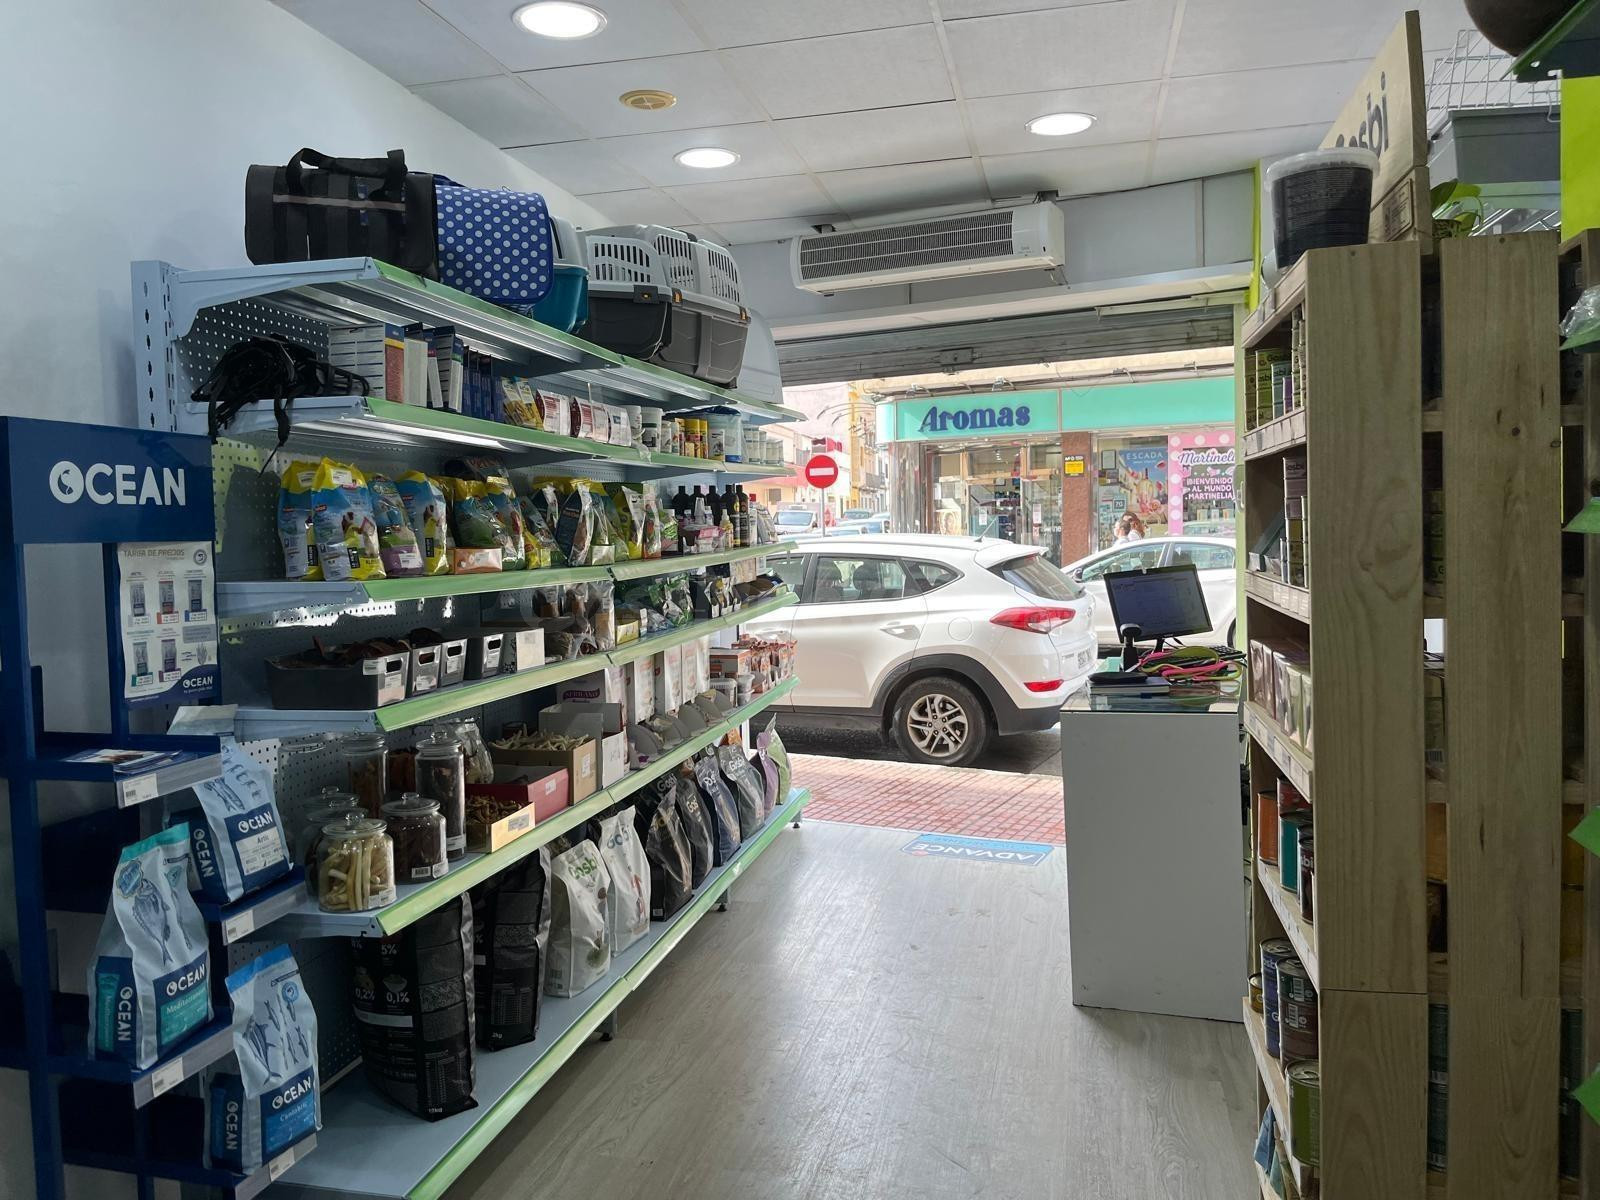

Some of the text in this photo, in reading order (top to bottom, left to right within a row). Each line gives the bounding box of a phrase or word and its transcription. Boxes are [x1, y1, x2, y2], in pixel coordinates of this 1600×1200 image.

[1335, 71, 1389, 159] sbi
[918, 406, 1031, 432] Aromas
[1126, 451, 1164, 461] ESCADA
[49, 460, 186, 506] OCEAN
[1188, 492, 1233, 500] MARTINELIA
[1204, 484, 1232, 492] MUNDO
[182, 676, 214, 688] OCEAN
[238, 811, 273, 834] OCEAN
[193, 828, 216, 878] OCEAN
[913, 843, 1035, 861] ADVANCE
[166, 963, 206, 996] OCEAN
[117, 986, 134, 1042] OCEAN
[271, 1076, 312, 1110] OCEAN
[226, 1101, 239, 1150] OCEAN
